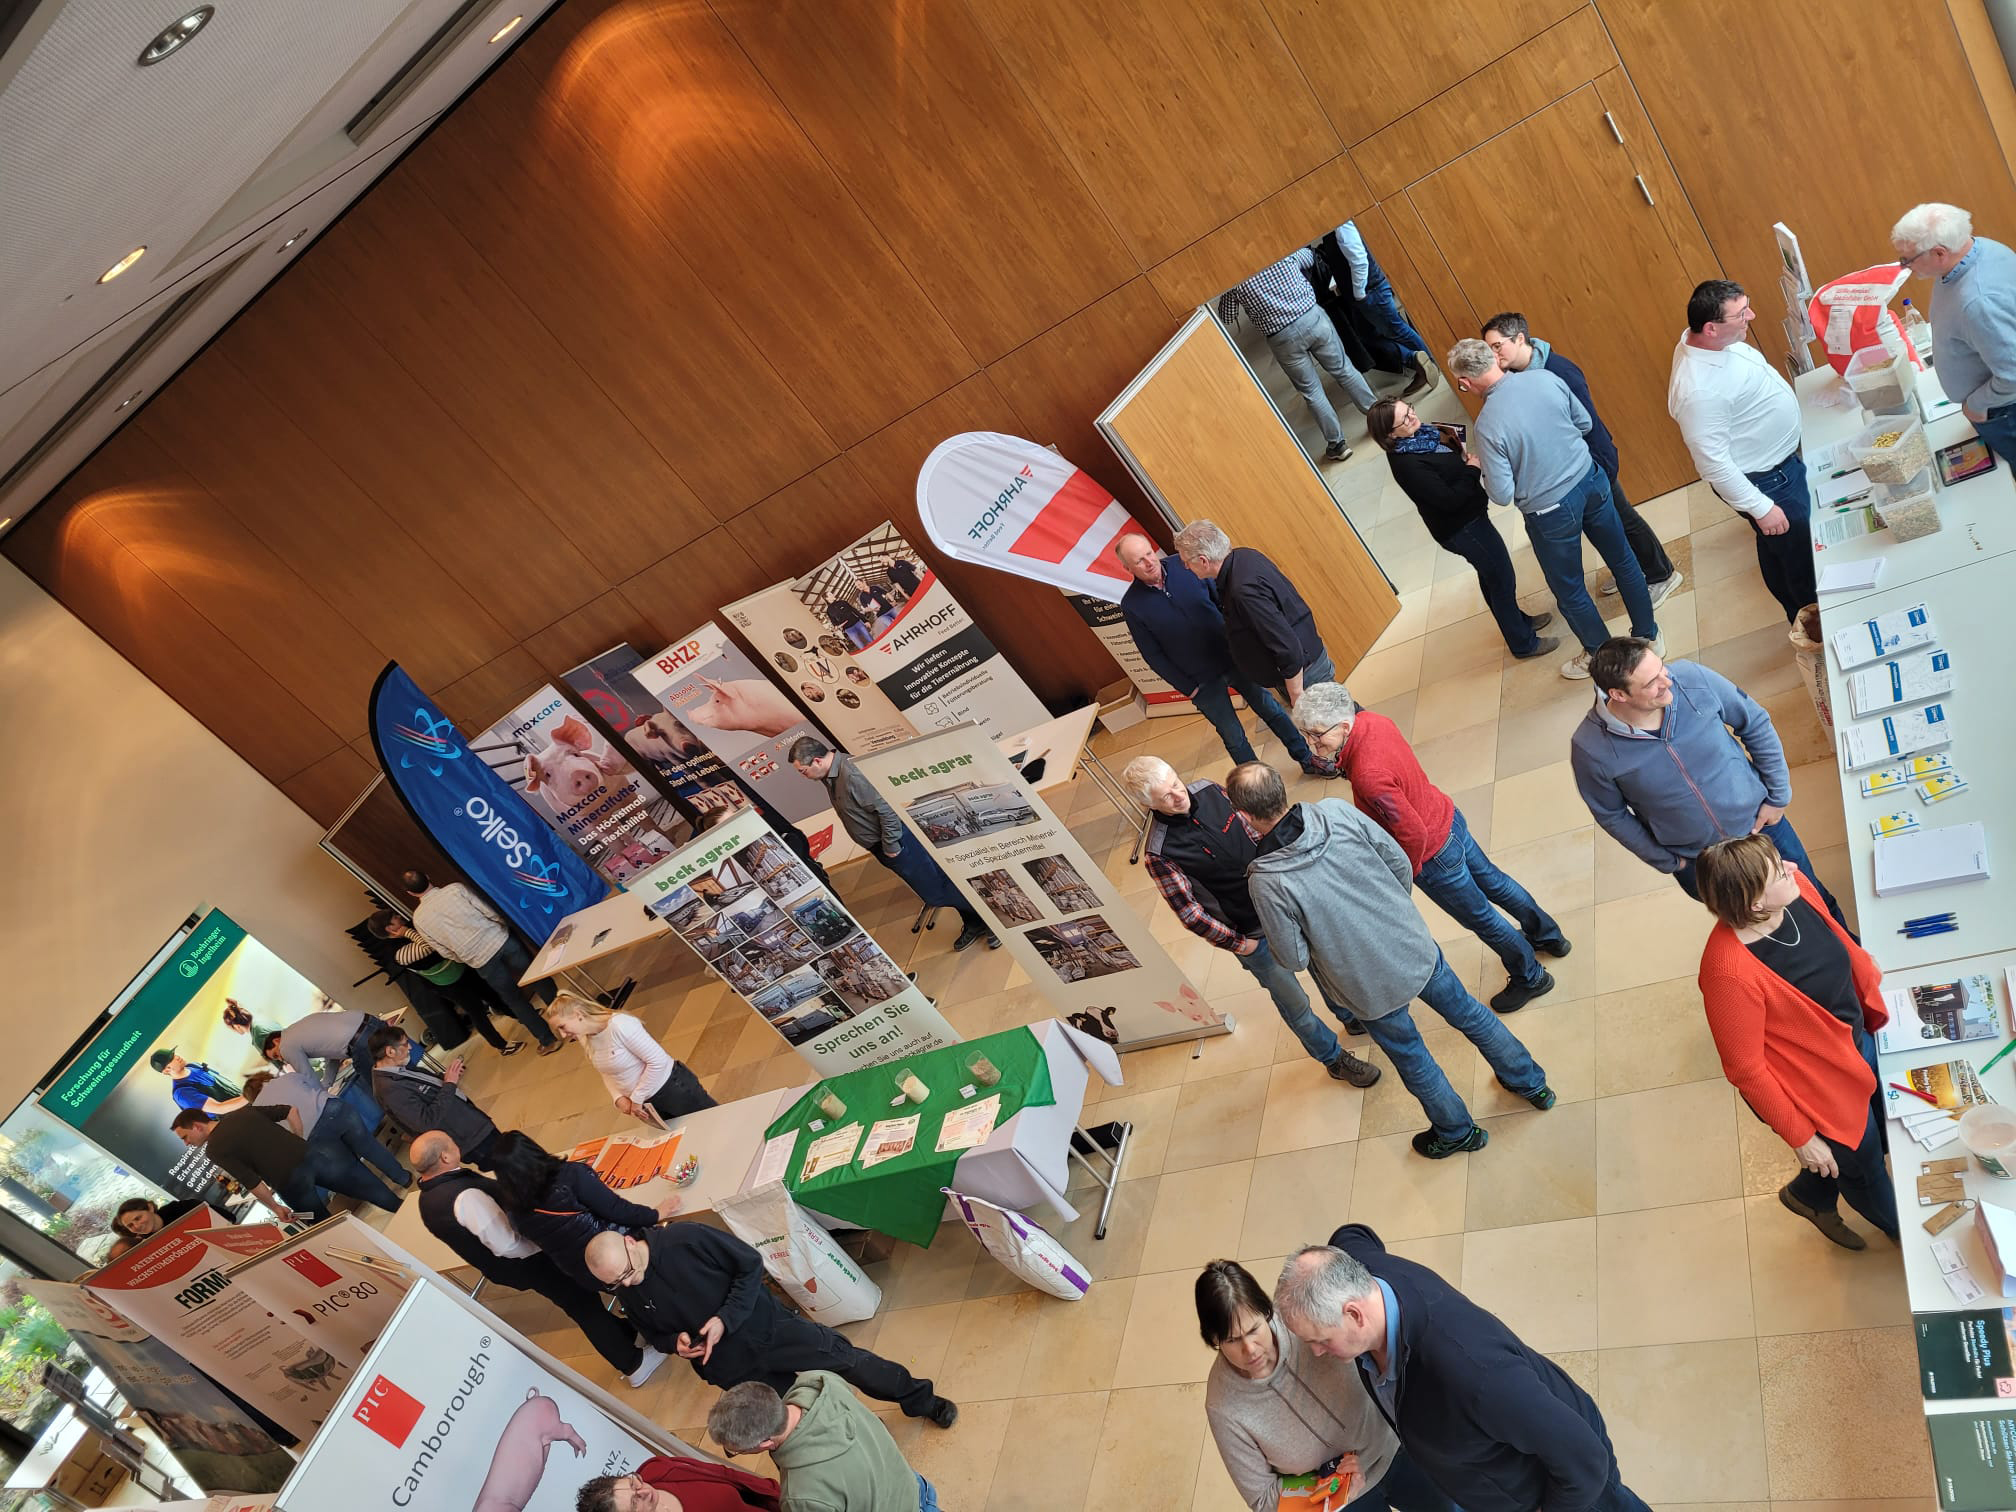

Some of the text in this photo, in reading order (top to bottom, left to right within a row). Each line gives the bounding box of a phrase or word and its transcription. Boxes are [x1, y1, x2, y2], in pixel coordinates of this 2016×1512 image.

[890, 602, 958, 651] AHRHOFF
[655, 637, 704, 677] BHZP
[903, 646, 970, 692] innovative Konzepte
[909, 653, 979, 700] für die Tierernährung
[911, 647, 948, 674] Wir liefern
[511, 697, 562, 739] maxcare
[670, 762, 686, 773] den
[888, 751, 975, 788] beck agrar
[555, 782, 608, 825] Maxcare
[566, 778, 642, 837] Mineralfutter
[577, 792, 648, 846] Das Höchstmaß
[466, 796, 532, 868] Selko
[588, 808, 650, 856] an Flexibilität
[955, 845, 989, 864] Spezialist
[988, 844, 998, 854] im
[997, 834, 1027, 851] Bereich
[1026, 826, 1058, 844] Mineral-
[653, 830, 743, 893] beck agrar
[968, 838, 1046, 869] und Spezialfuttermittel
[190, 924, 223, 959] Boehringer
[197, 933, 227, 965] Ingelheim
[813, 998, 910, 1058] Sprechen Sie
[848, 1021, 904, 1060] uns an!
[876, 1052, 889, 1063] Sie
[889, 1046, 903, 1057] uns
[902, 1037, 920, 1050] auch
[920, 1031, 932, 1041] auf
[60, 1047, 112, 1103] Forschung für
[69, 1028, 145, 1109] Schweinegesundheit
[192, 1176, 208, 1193] und
[129, 1234, 183, 1275] PATENTIERTER
[285, 1246, 312, 1270] PIC
[1975, 1319, 1992, 1367] Speedy Plus
[355, 1378, 392, 1424] PIC
